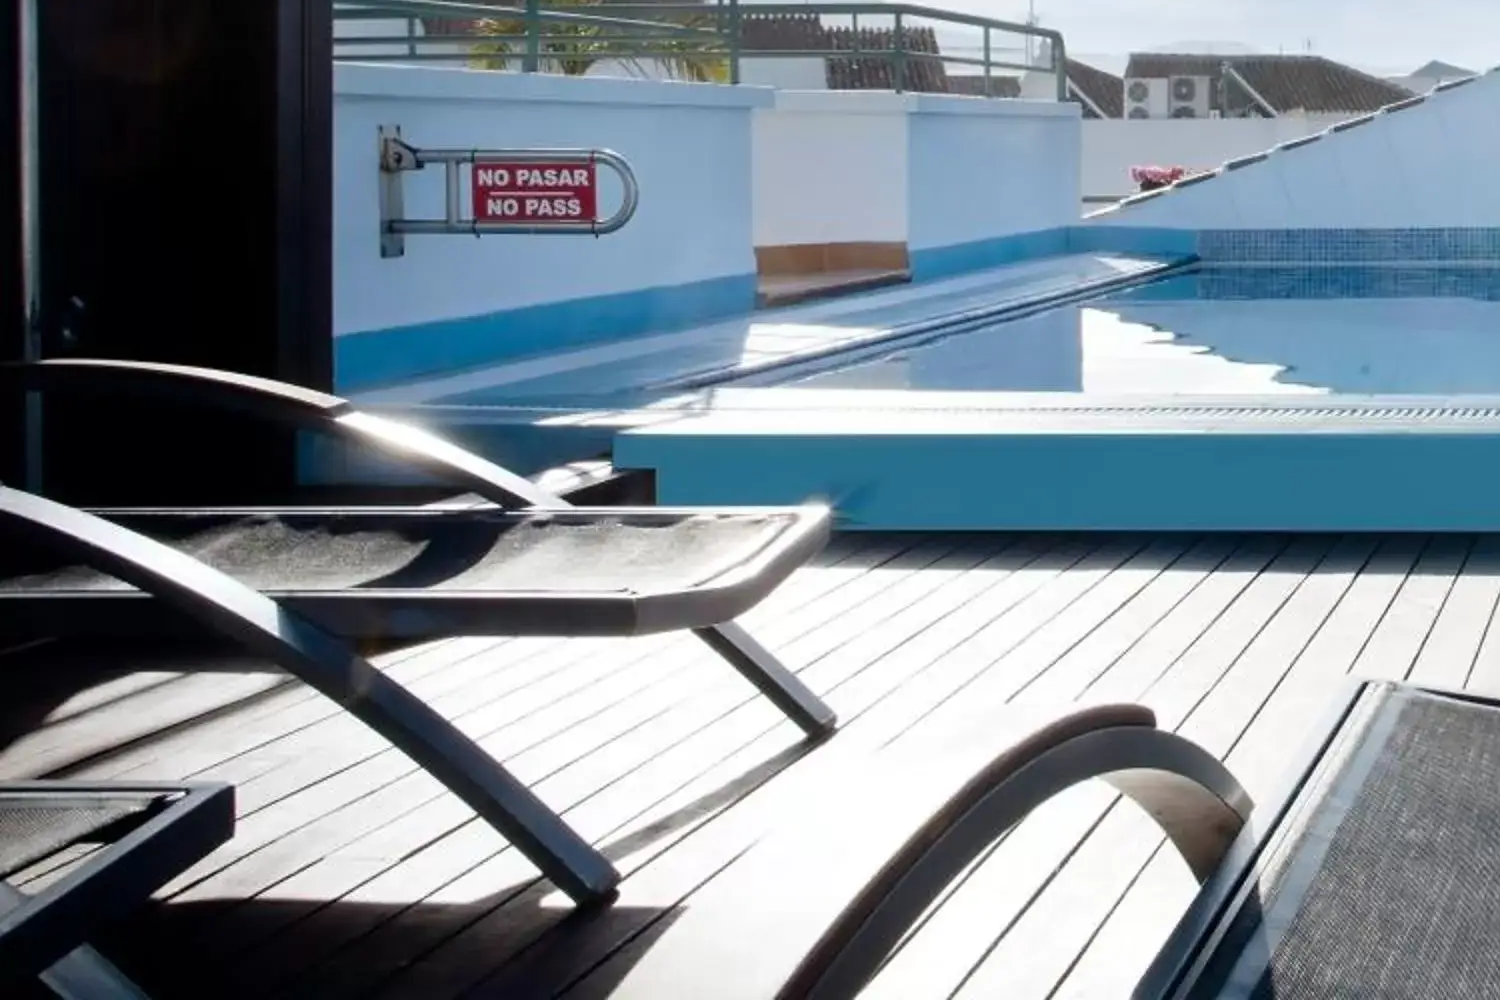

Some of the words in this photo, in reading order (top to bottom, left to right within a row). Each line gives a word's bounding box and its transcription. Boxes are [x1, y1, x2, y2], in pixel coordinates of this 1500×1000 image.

[477, 169, 509, 187] NO
[516, 169, 589, 187] PASAR
[487, 199, 519, 216] NO
[525, 199, 582, 216] PASS
